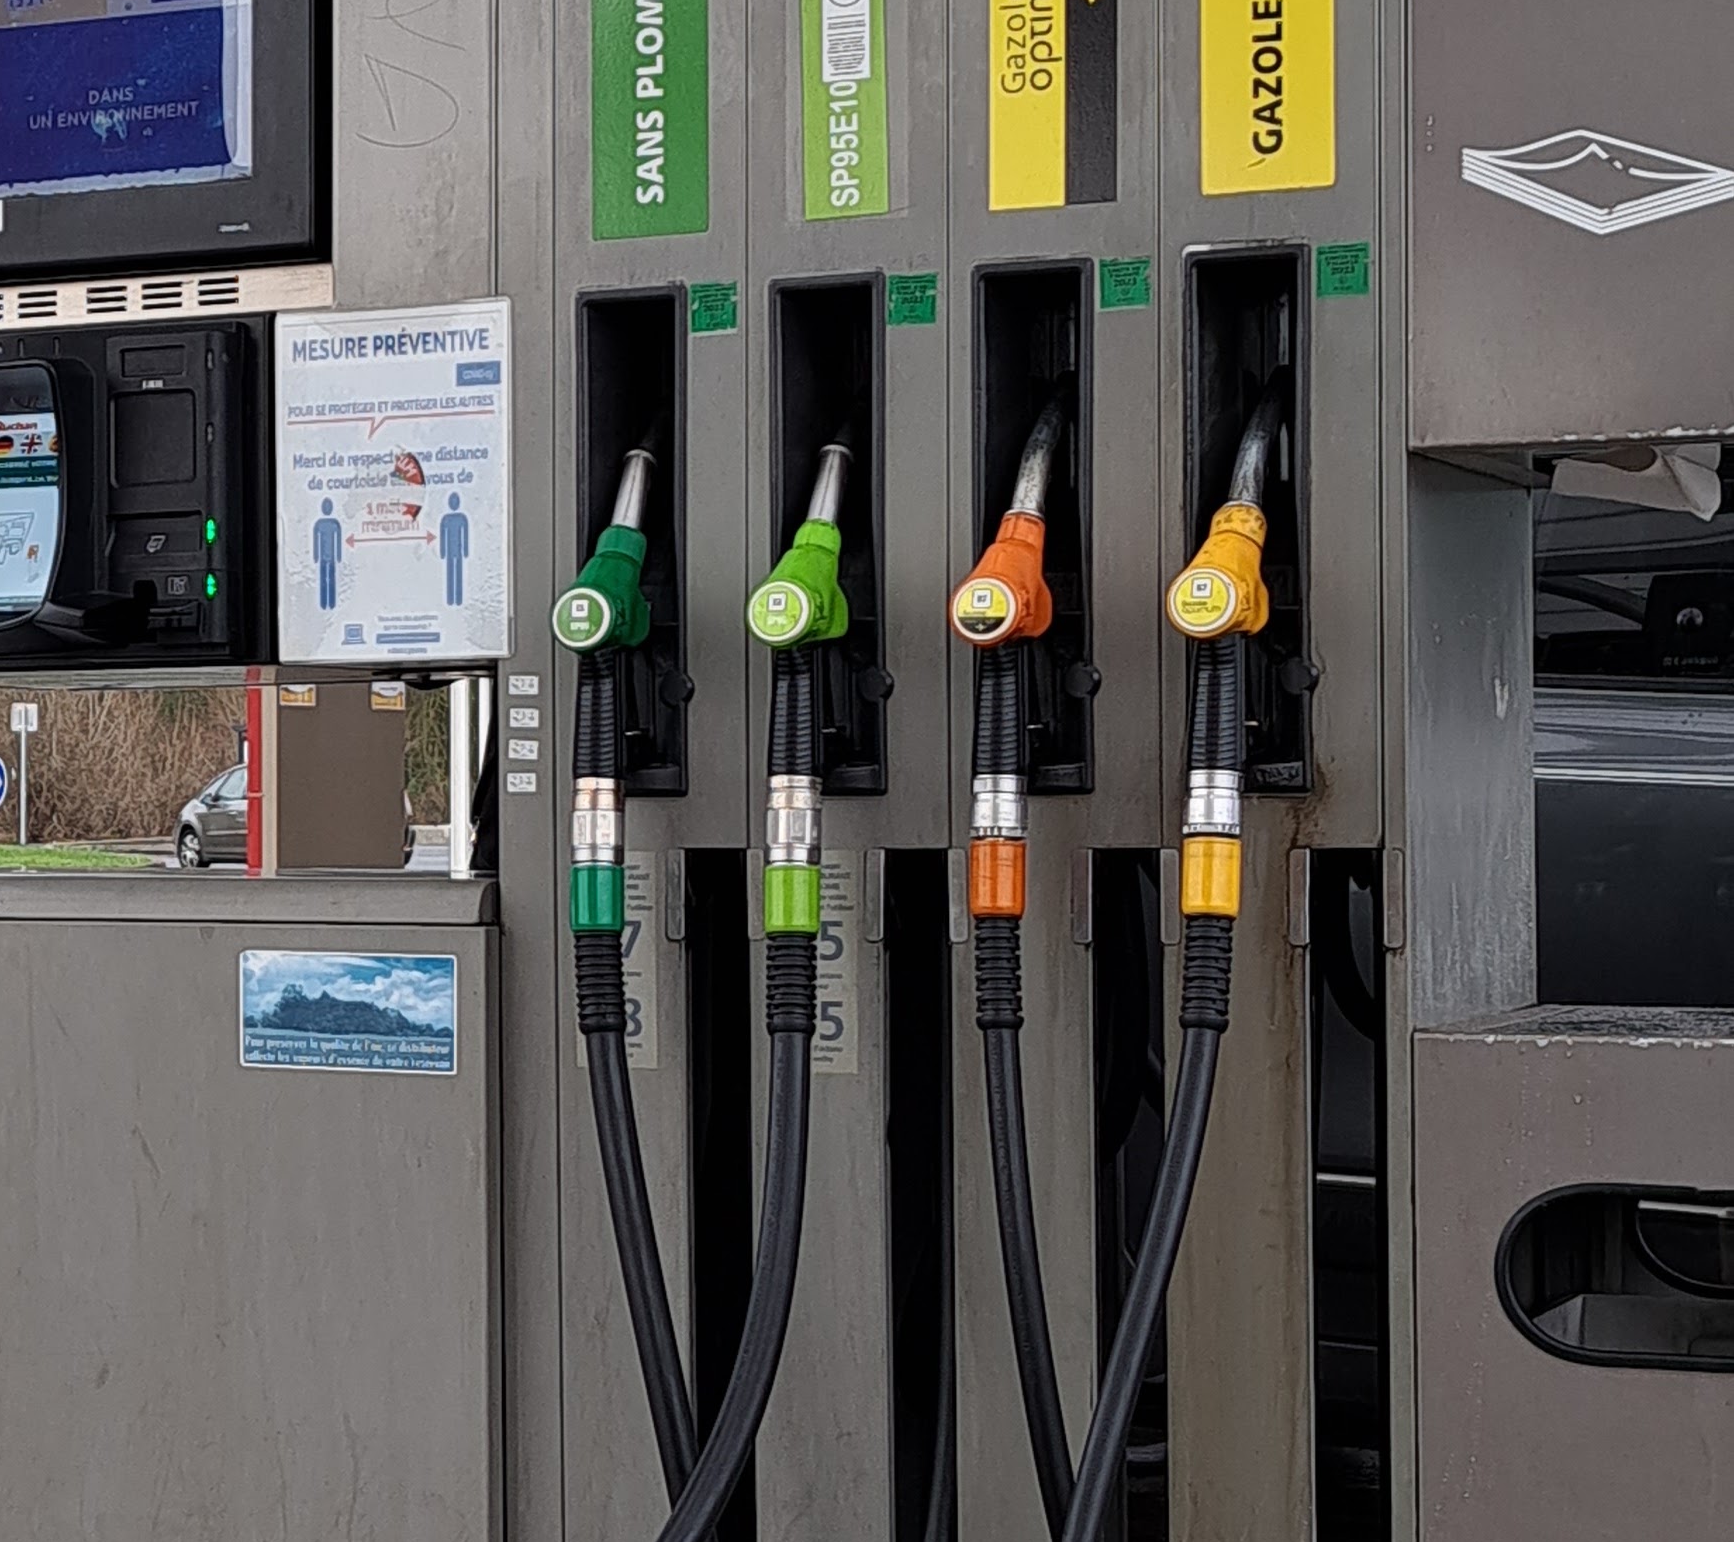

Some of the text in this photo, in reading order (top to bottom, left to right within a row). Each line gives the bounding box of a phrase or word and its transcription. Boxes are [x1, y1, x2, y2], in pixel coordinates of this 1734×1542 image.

[88, 87, 133, 105] DANS
[29, 100, 200, 131] UN ENVIRONNEMENT
[636, 109, 665, 205] SANS
[829, 81, 860, 207] SP95E10
[292, 327, 490, 362] MESURE PRÉVENTIVE
[288, 406, 314, 418] POUR
[378, 400, 389, 413] ET
[440, 396, 456, 409] LES
[293, 452, 326, 470] Merci
[329, 451, 345, 468] de
[435, 445, 489, 462] distance
[307, 474, 323, 491] de
[456, 468, 474, 484] de
[622, 920, 642, 958] 7
[819, 920, 845, 961] 5
[819, 1001, 845, 1042] 5
